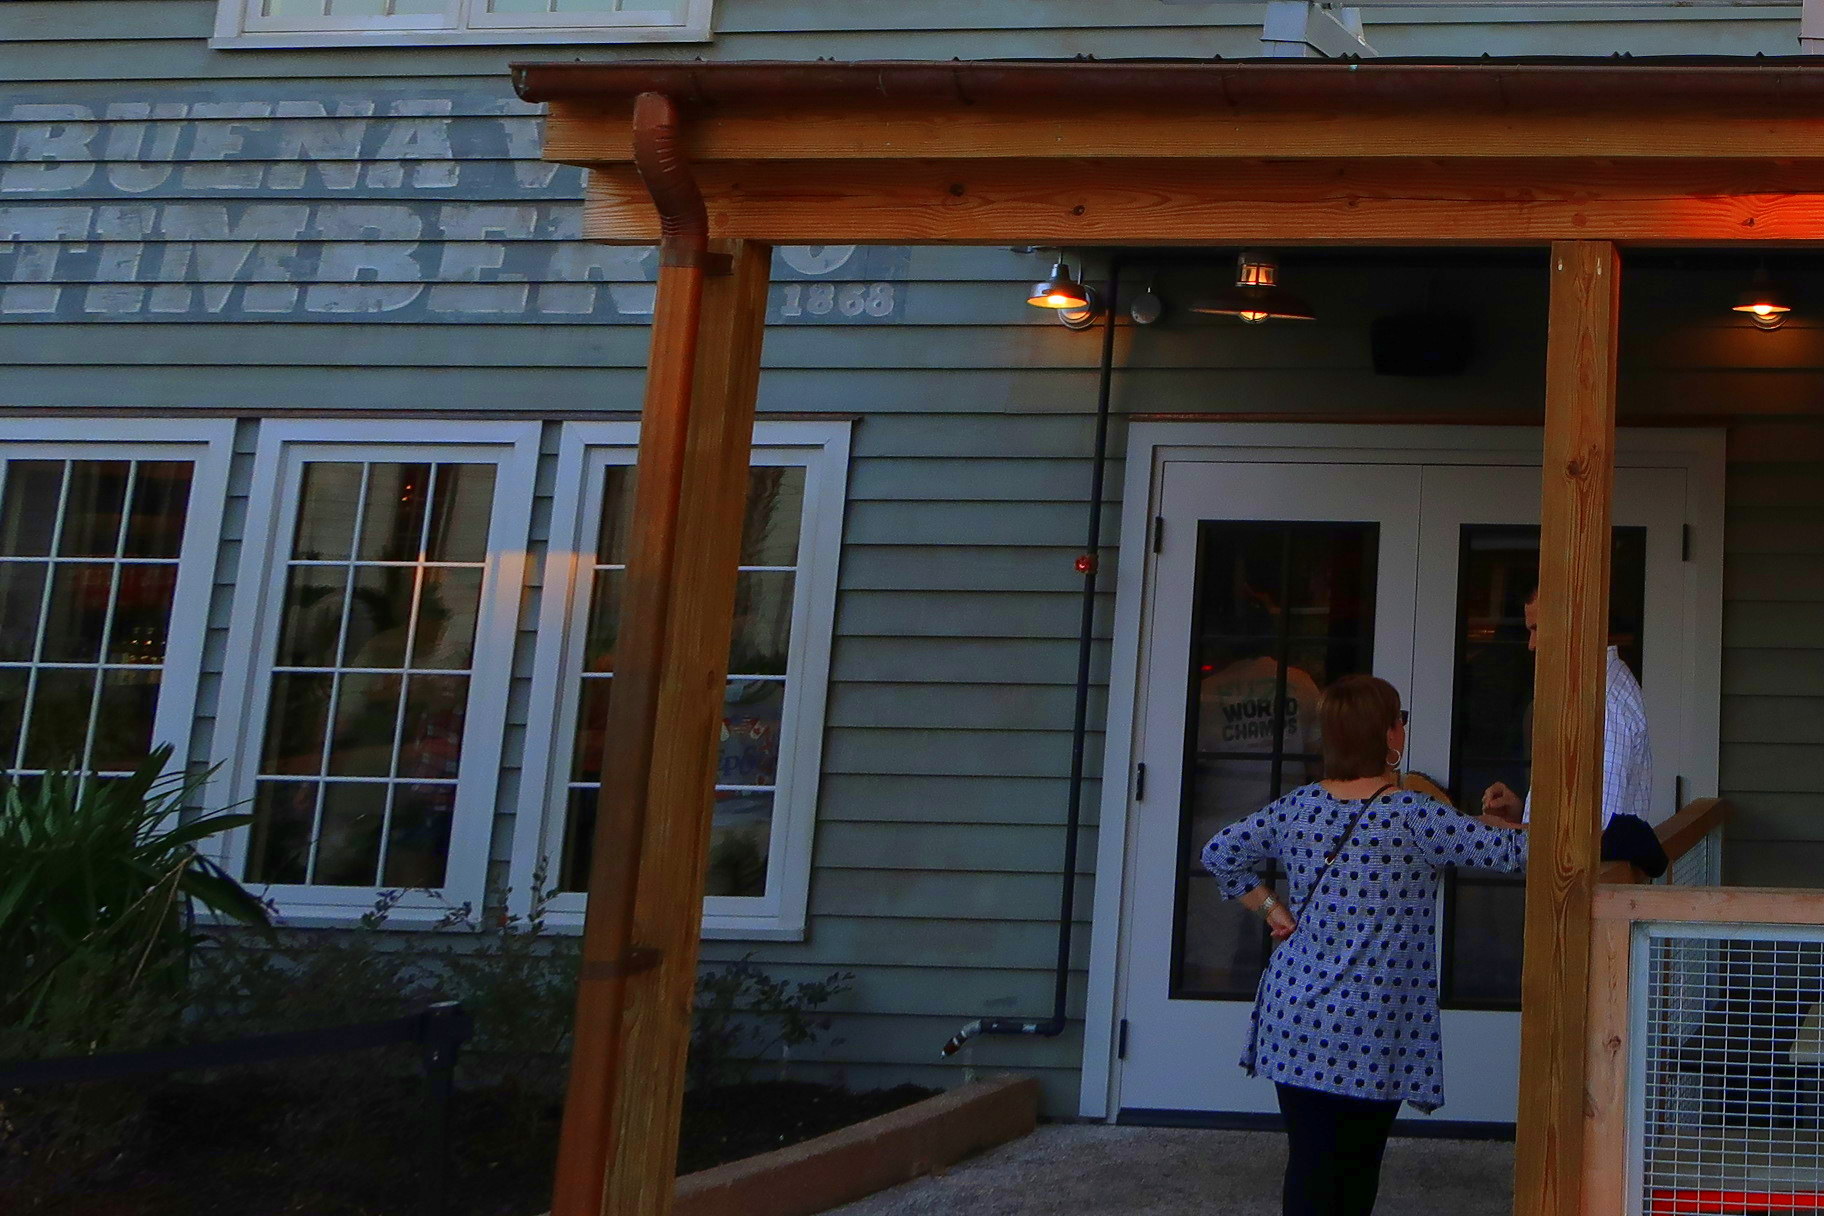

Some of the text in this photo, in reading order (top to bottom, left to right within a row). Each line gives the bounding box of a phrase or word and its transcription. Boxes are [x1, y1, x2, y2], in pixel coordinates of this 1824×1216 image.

[1, 99, 459, 193] BUENA
[780, 282, 895, 317] 1868
[1222, 697, 1298, 723] WORD
[1221, 717, 1298, 742] CHAMS
